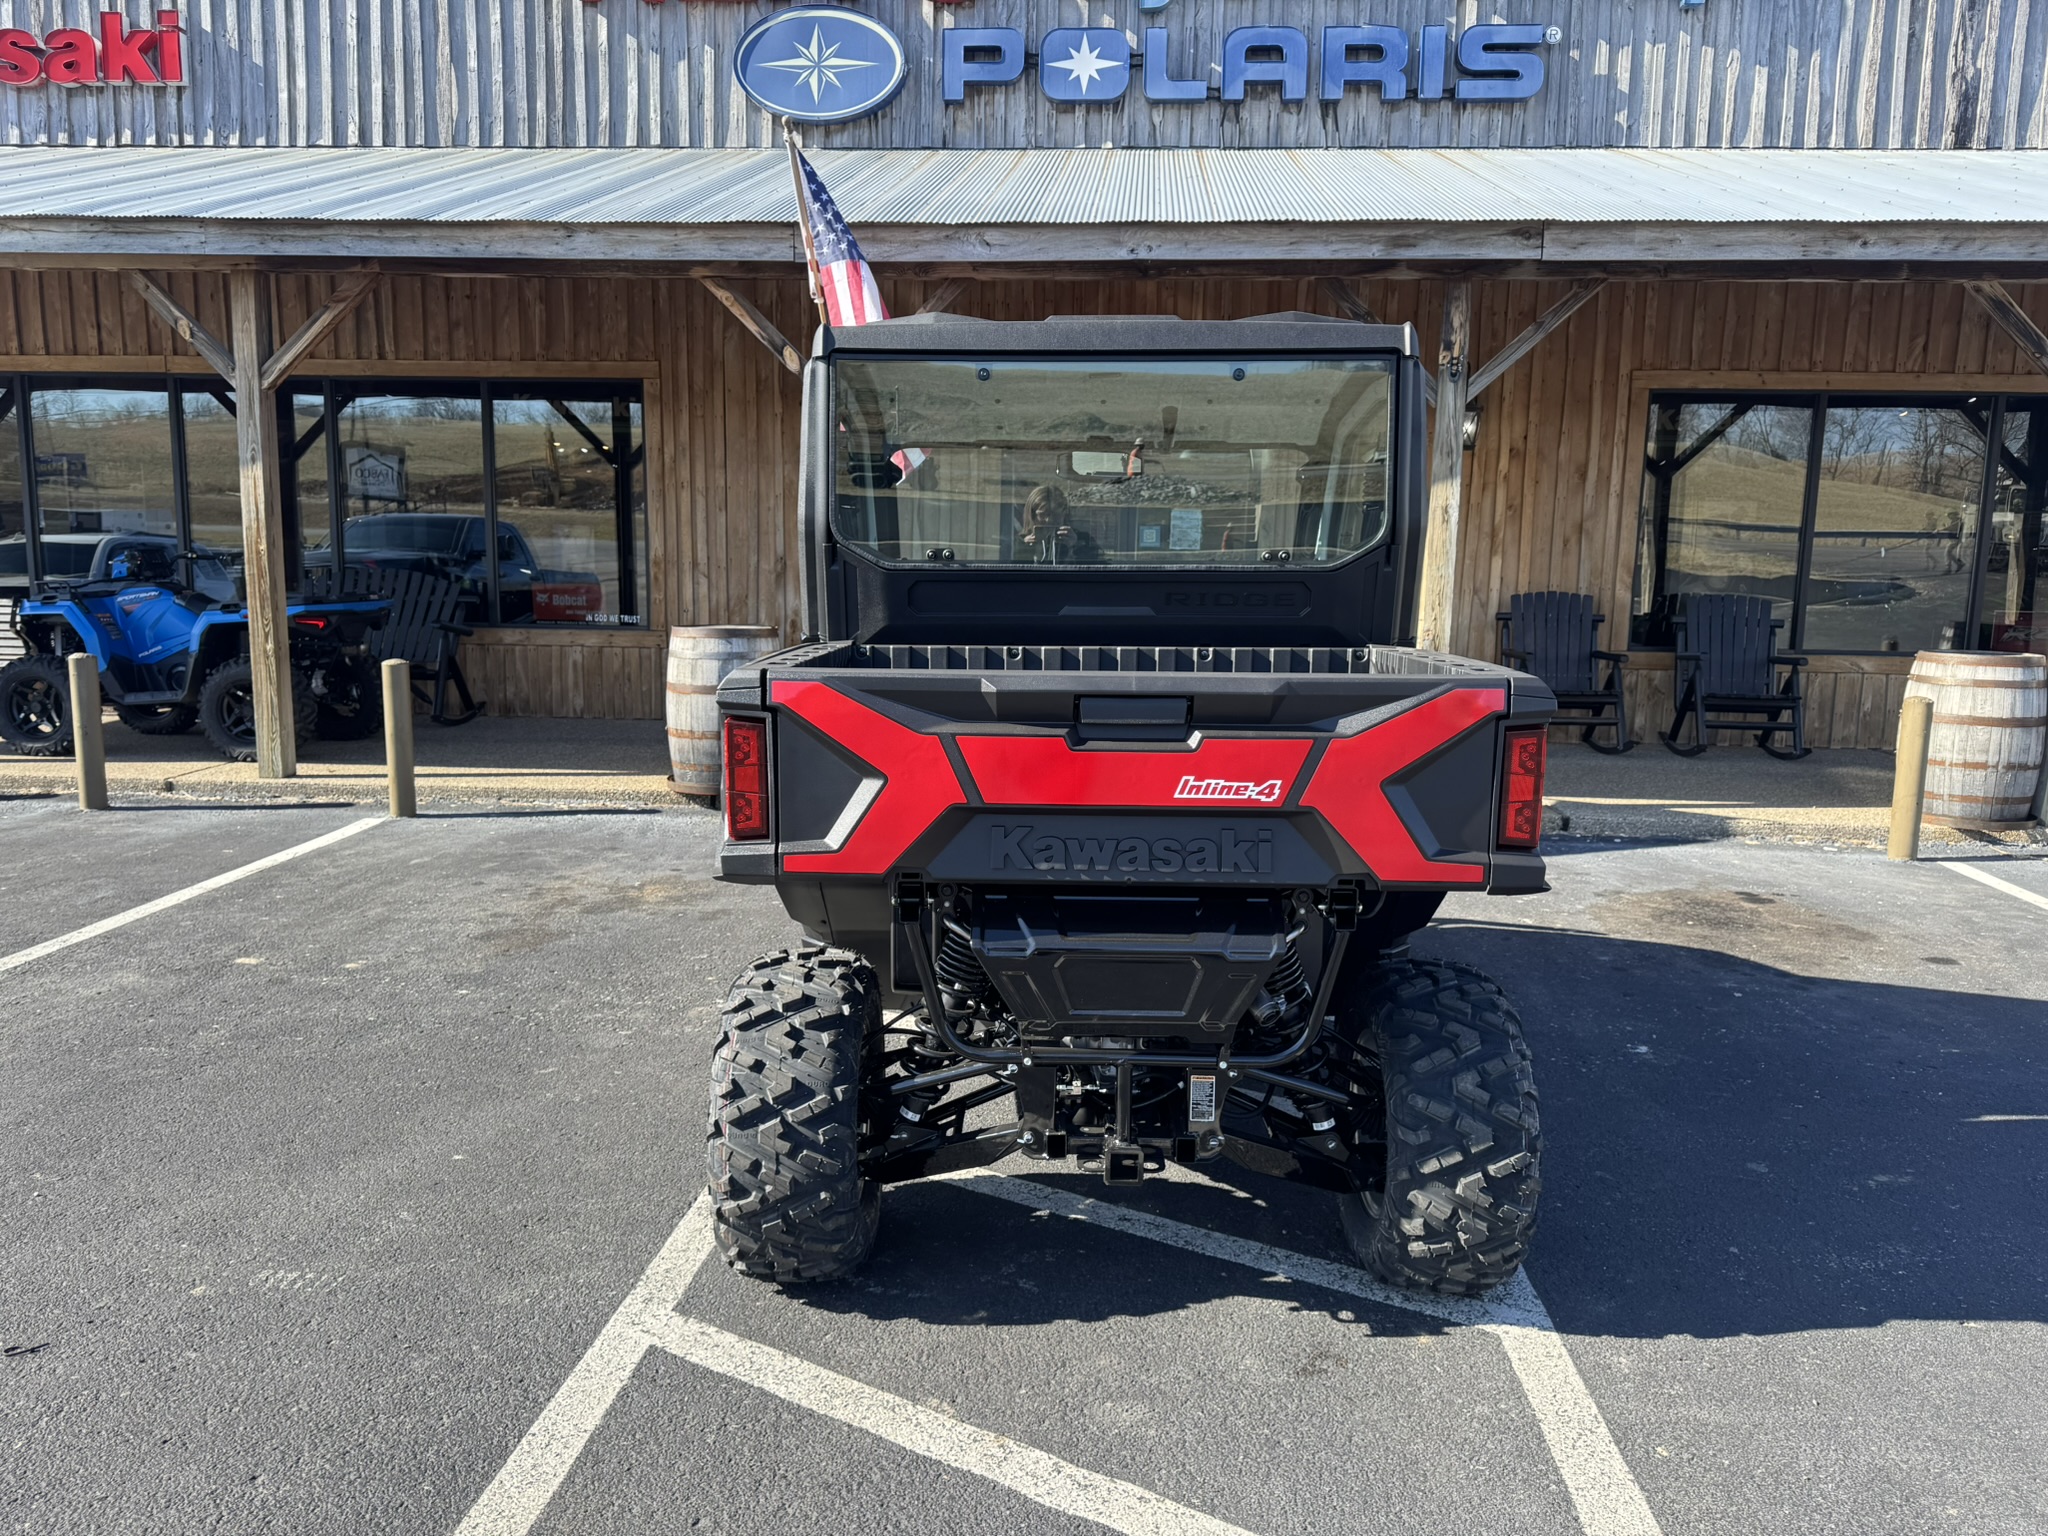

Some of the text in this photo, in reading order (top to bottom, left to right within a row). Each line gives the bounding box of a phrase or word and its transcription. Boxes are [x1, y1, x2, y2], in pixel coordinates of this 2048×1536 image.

[552, 594, 587, 606] Bobcat
[1164, 591, 1297, 607] RIDGE
[594, 613, 608, 622] GOD
[609, 614, 619, 623] WE
[620, 614, 641, 623] TRUST
[1173, 775, 1283, 802] Inline-4
[990, 825, 1273, 873] Kawasaki
